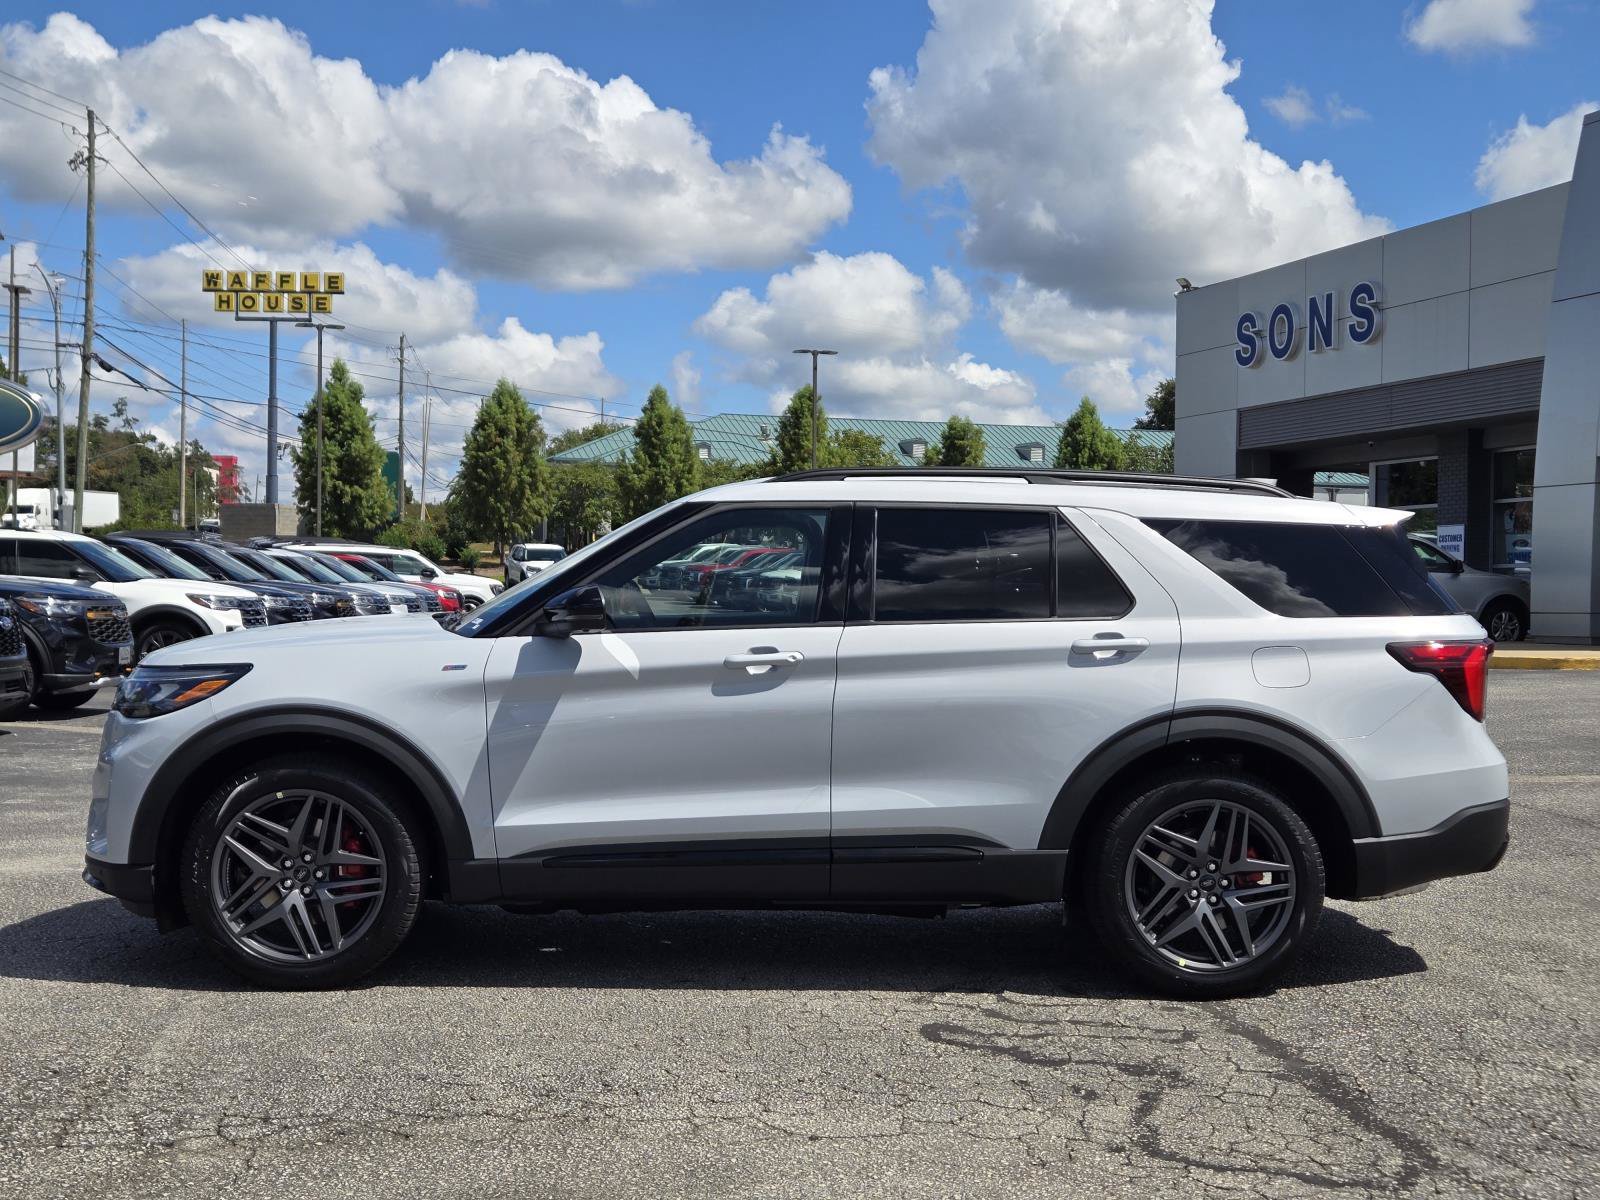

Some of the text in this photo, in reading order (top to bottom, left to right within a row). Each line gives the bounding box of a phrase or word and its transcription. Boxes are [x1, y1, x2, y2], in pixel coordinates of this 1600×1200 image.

[204, 272, 340, 290] WAFFLE
[217, 295, 329, 311] HOUSE
[1234, 281, 1378, 368] SONS
[1438, 534, 1463, 543] CUSTOMER
